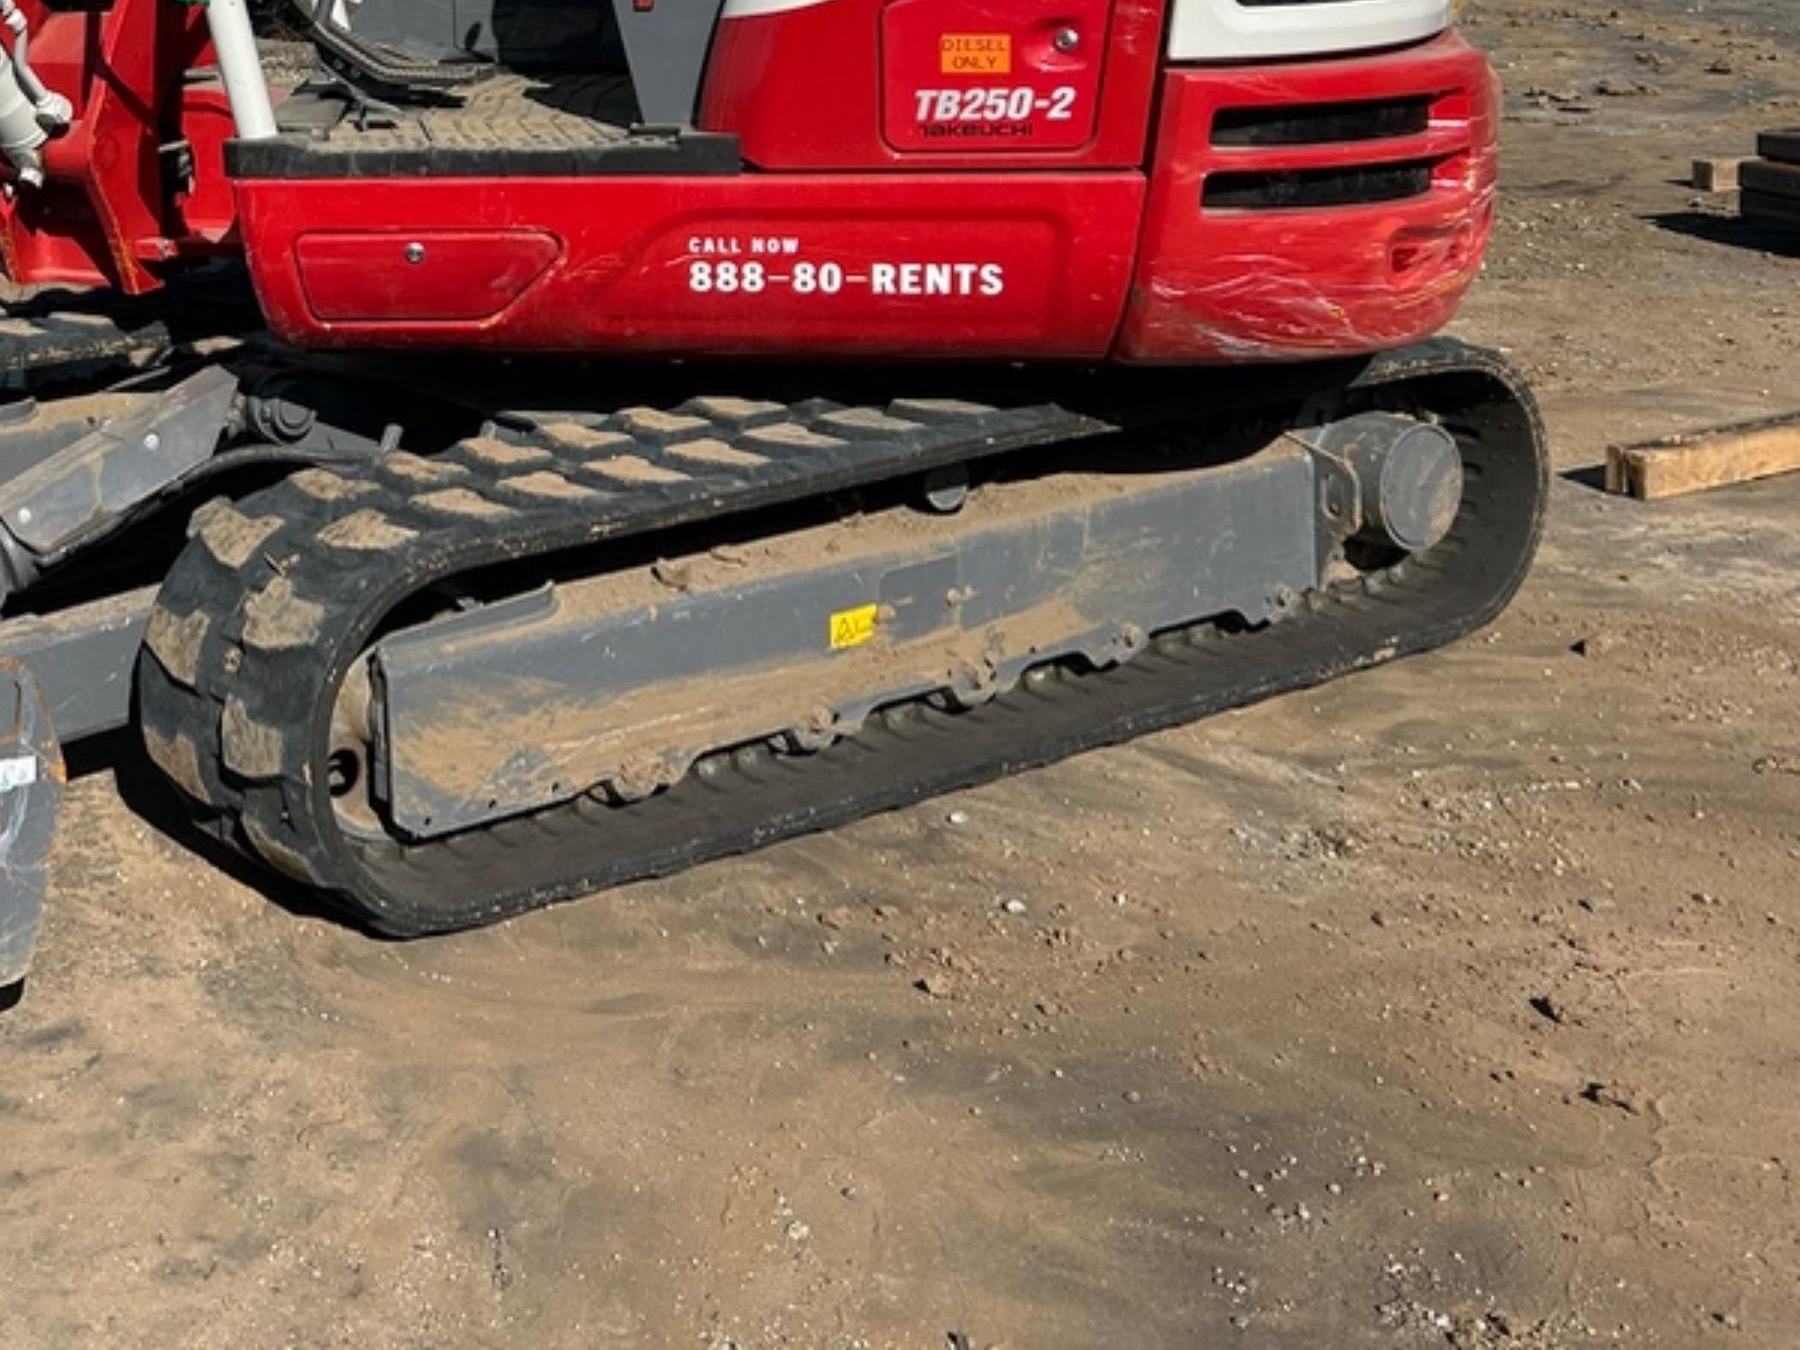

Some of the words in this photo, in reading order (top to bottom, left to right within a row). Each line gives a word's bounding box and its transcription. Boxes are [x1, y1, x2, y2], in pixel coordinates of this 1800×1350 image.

[942, 38, 1006, 52] DIESEL
[953, 56, 997, 69] ONLY
[915, 86, 1077, 121] TB250-2
[688, 237, 741, 253] CALL
[751, 237, 799, 253] NOW
[689, 261, 1004, 295] 888-80-RENTS
